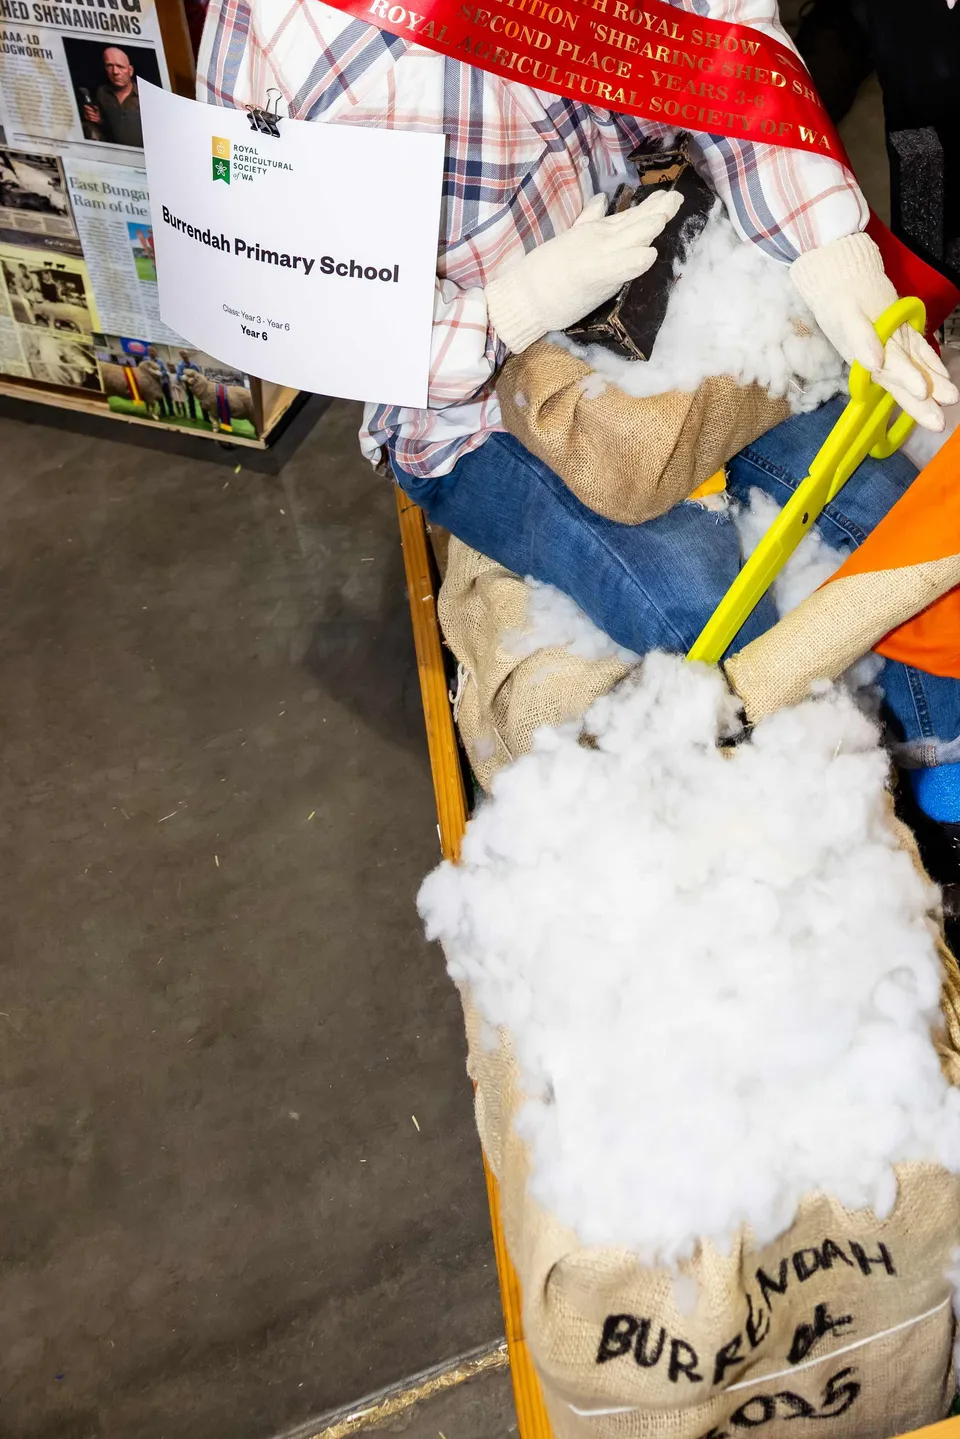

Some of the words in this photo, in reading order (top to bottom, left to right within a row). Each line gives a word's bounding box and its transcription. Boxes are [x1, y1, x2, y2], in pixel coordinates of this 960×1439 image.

[33, 3, 142, 36] SHENANIGANS
[456, 3, 553, 52] SECOND
[555, 38, 632, 79] PLACE
[650, 69, 729, 102] YEARS
[734, 89, 766, 108] 3-6
[589, 20, 717, 74] "SHEARING
[720, 61, 787, 89] SHED
[690, 28, 761, 58] SHOW
[456, 35, 644, 109] AGRICULTURAL
[648, 95, 751, 133] SOCIETY
[759, 118, 793, 138] OF
[798, 125, 832, 151] WA
[233, 144, 259, 155] ROYAL
[233, 153, 294, 171] AGRICULTURAL
[233, 162, 268, 175] SOCIETY
[233, 172, 241, 180] of
[241, 173, 254, 182] WA
[69, 176, 99, 192] East
[72, 193, 107, 210] Ram
[109, 201, 125, 214] of
[125, 202, 148, 217] the
[162, 204, 231, 254] Burrendah
[234, 237, 316, 276] Primary
[319, 255, 400, 283] School
[222, 303, 241, 318] Class:
[240, 310, 256, 324] Year
[256, 315, 262, 324] 3
[267, 318, 284, 330] Year
[284, 323, 291, 331] 6
[240, 324, 261, 341] Year
[261, 331, 268, 341] 6
[595, 1237, 899, 1385] BURRENDAH
